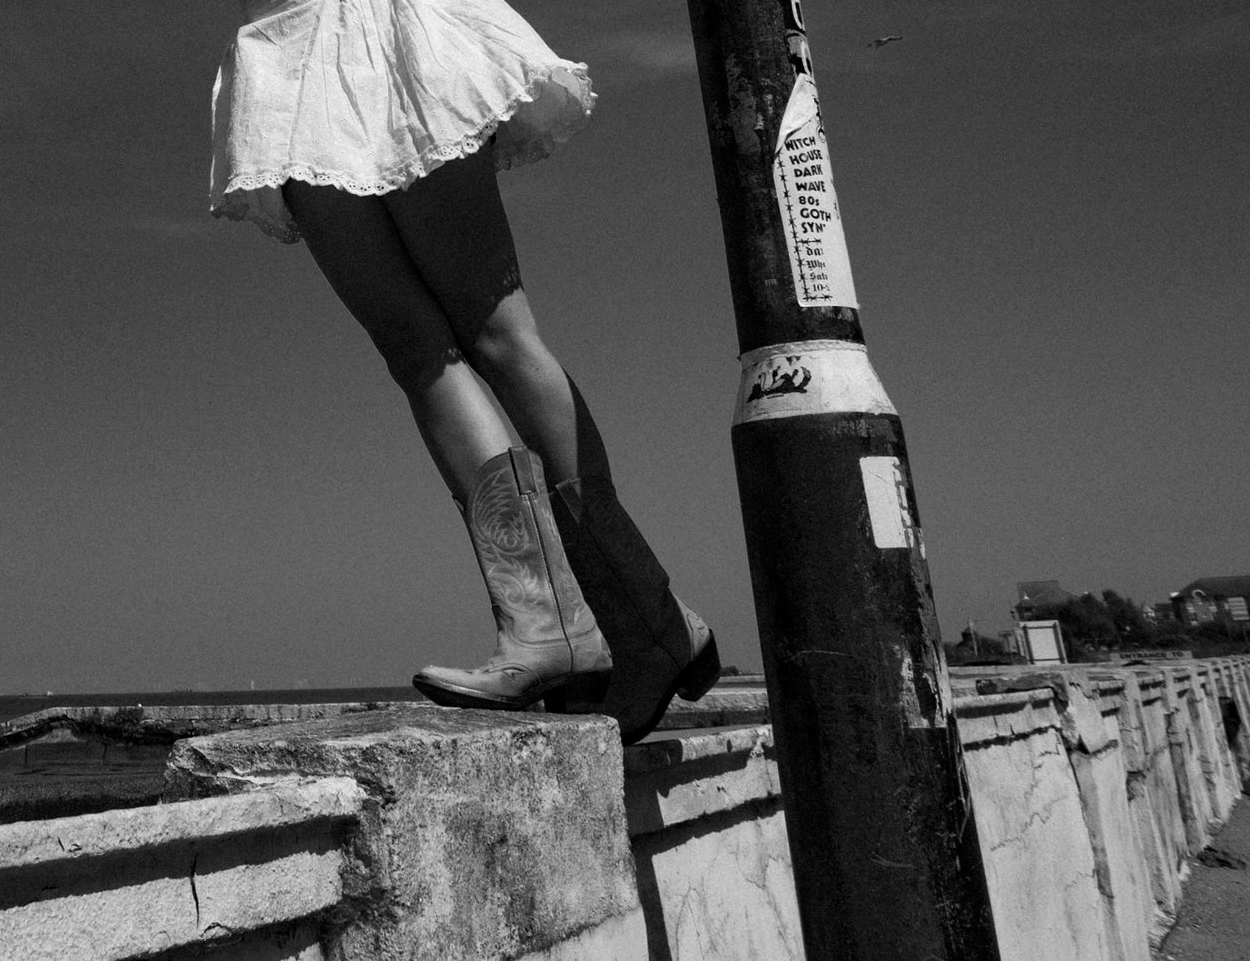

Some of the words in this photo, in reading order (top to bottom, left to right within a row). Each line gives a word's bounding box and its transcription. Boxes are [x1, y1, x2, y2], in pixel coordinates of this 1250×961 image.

[784, 136, 816, 151] WITCH
[789, 149, 823, 165] HOUSE
[793, 164, 823, 178] DARK
[795, 181, 826, 193] WAVE
[798, 196, 820, 206] 80s
[800, 207, 832, 222] GOTH
[801, 222, 826, 234] SYN
